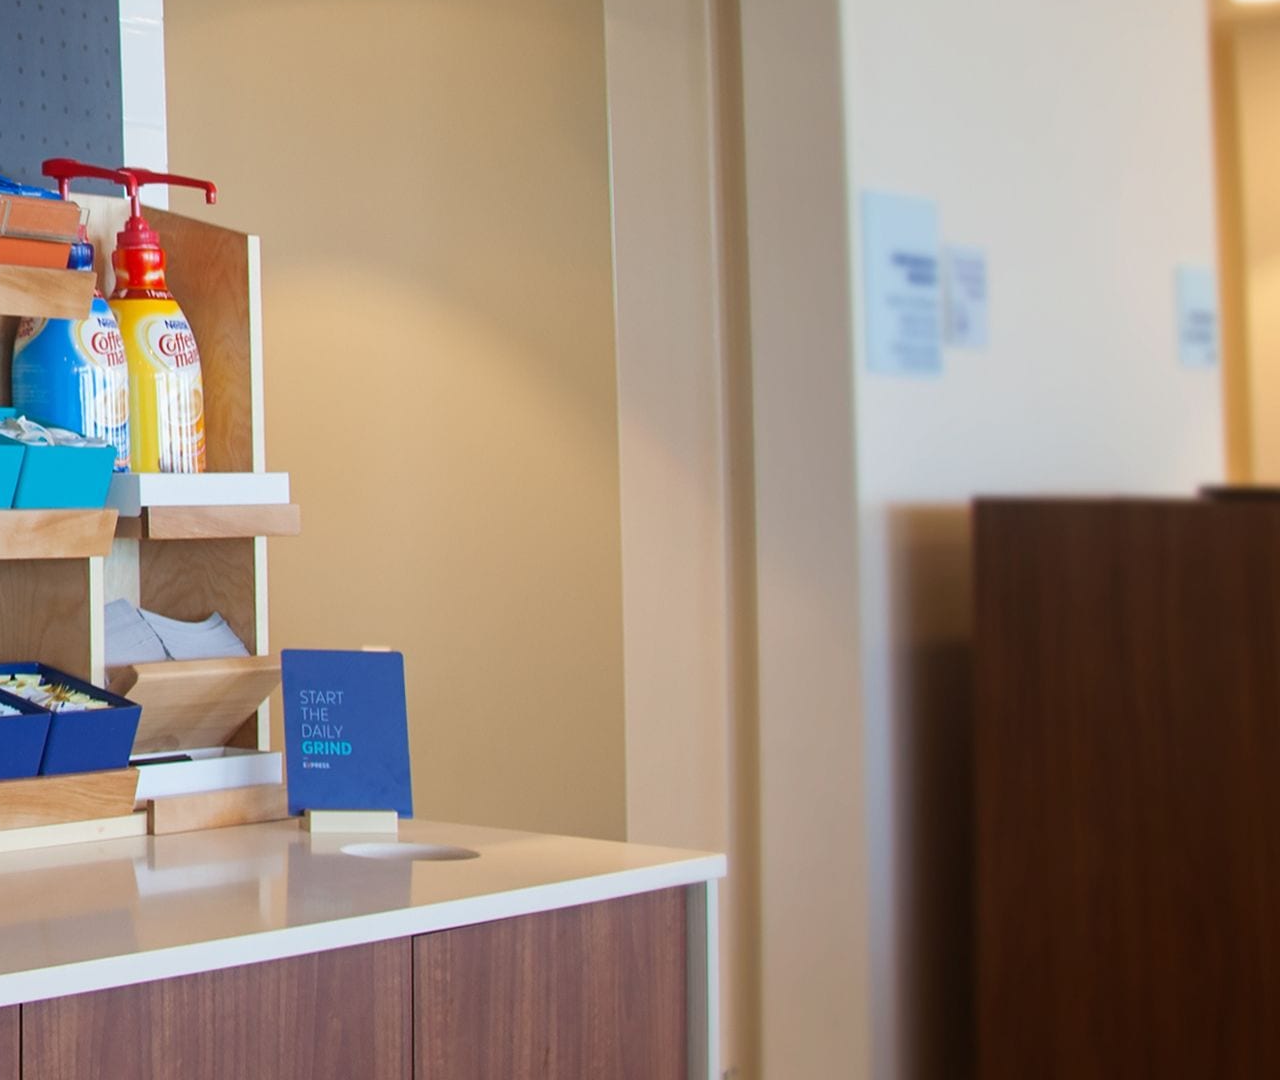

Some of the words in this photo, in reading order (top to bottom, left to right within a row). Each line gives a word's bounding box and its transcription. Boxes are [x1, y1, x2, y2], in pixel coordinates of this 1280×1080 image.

[91, 331, 124, 355] Coffe
[299, 689, 344, 705] START
[301, 706, 329, 721] THE
[301, 724, 343, 739] DAILY
[302, 741, 352, 756] GRIND
